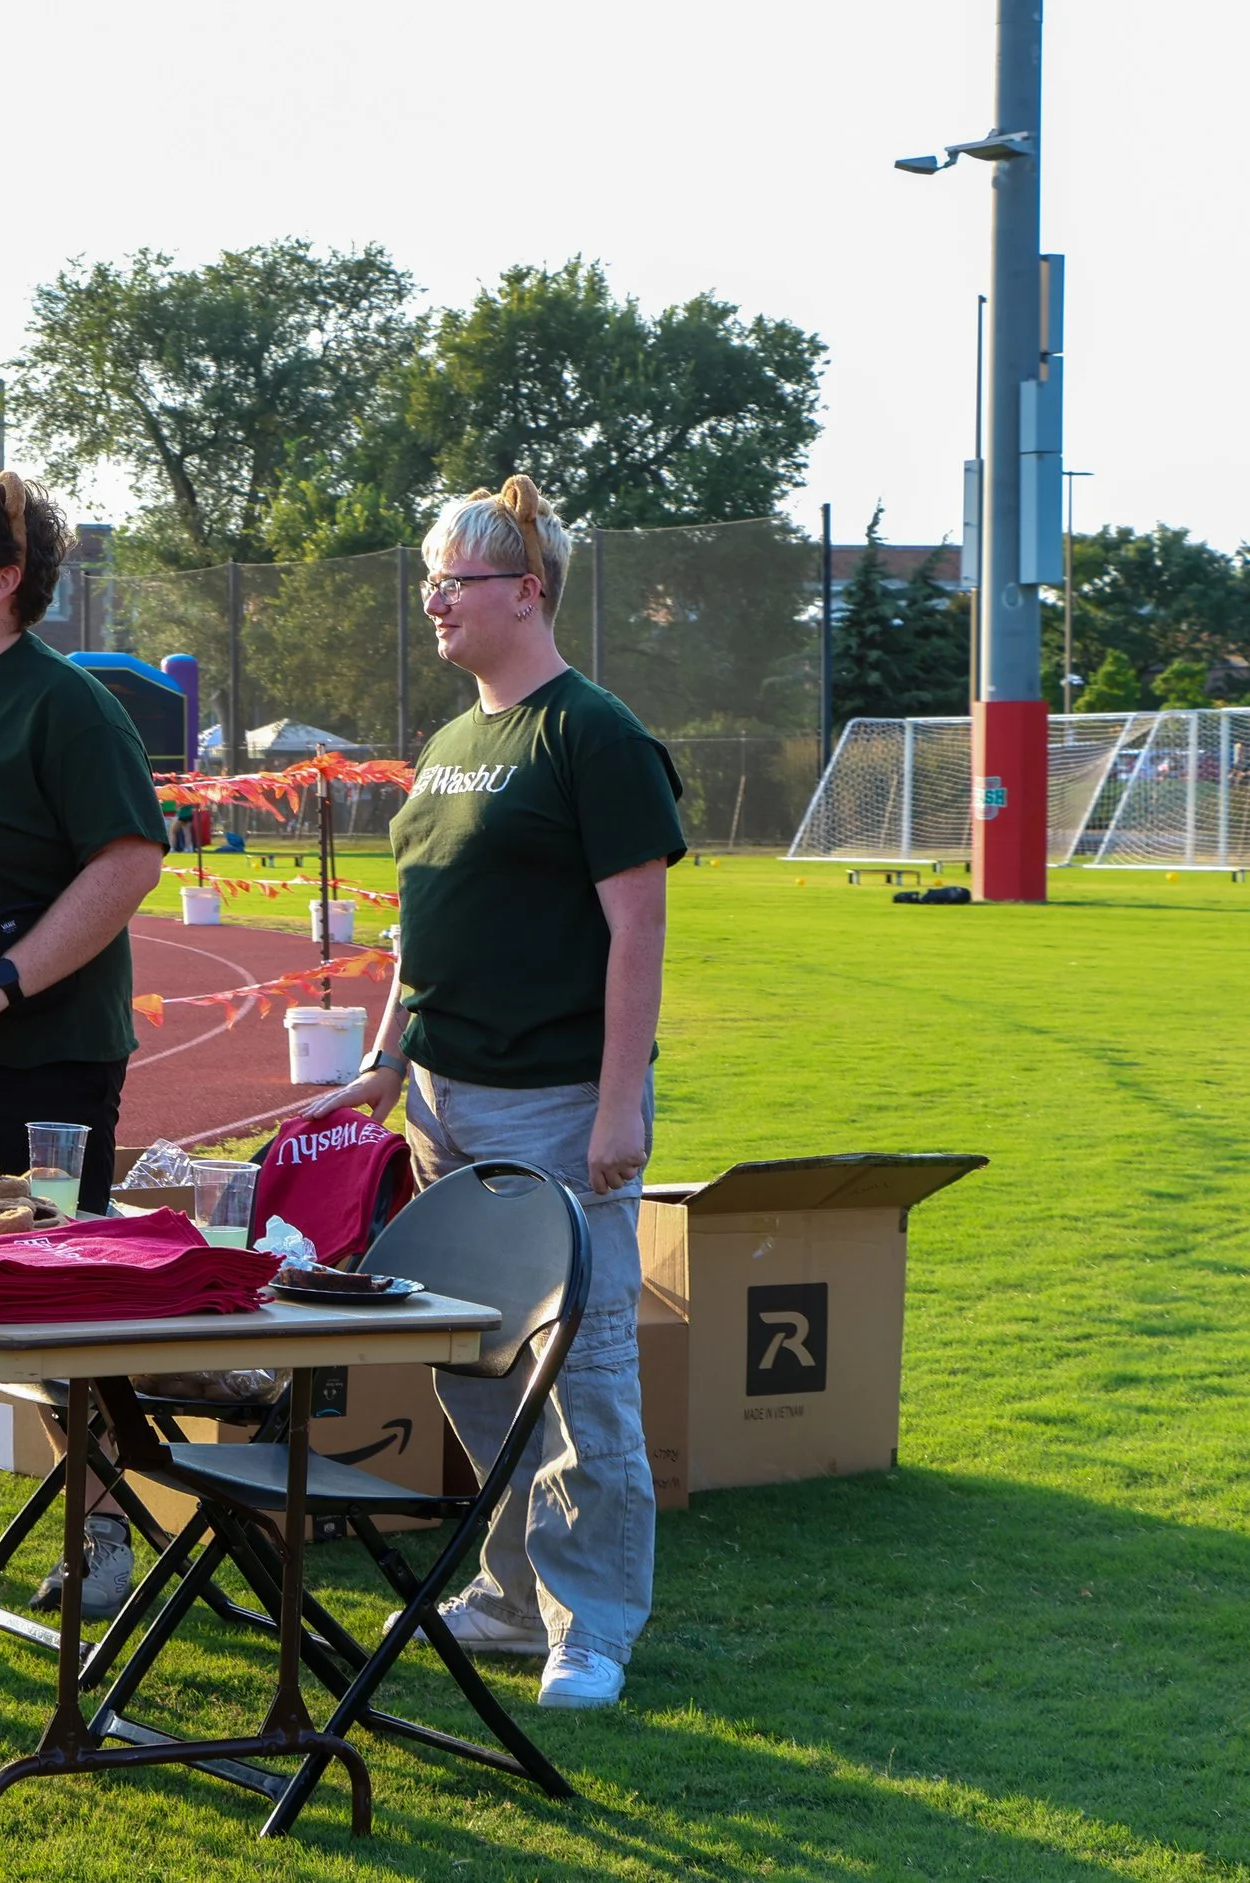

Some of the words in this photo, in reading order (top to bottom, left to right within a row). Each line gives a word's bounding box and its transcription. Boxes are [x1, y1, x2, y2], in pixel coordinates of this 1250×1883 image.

[430, 764, 518, 795] WashU
[275, 1121, 358, 1166] WashU
[758, 1311, 816, 1370] R
[743, 1408, 765, 1421] MADE
[773, 1404, 805, 1419] VIETNAM
